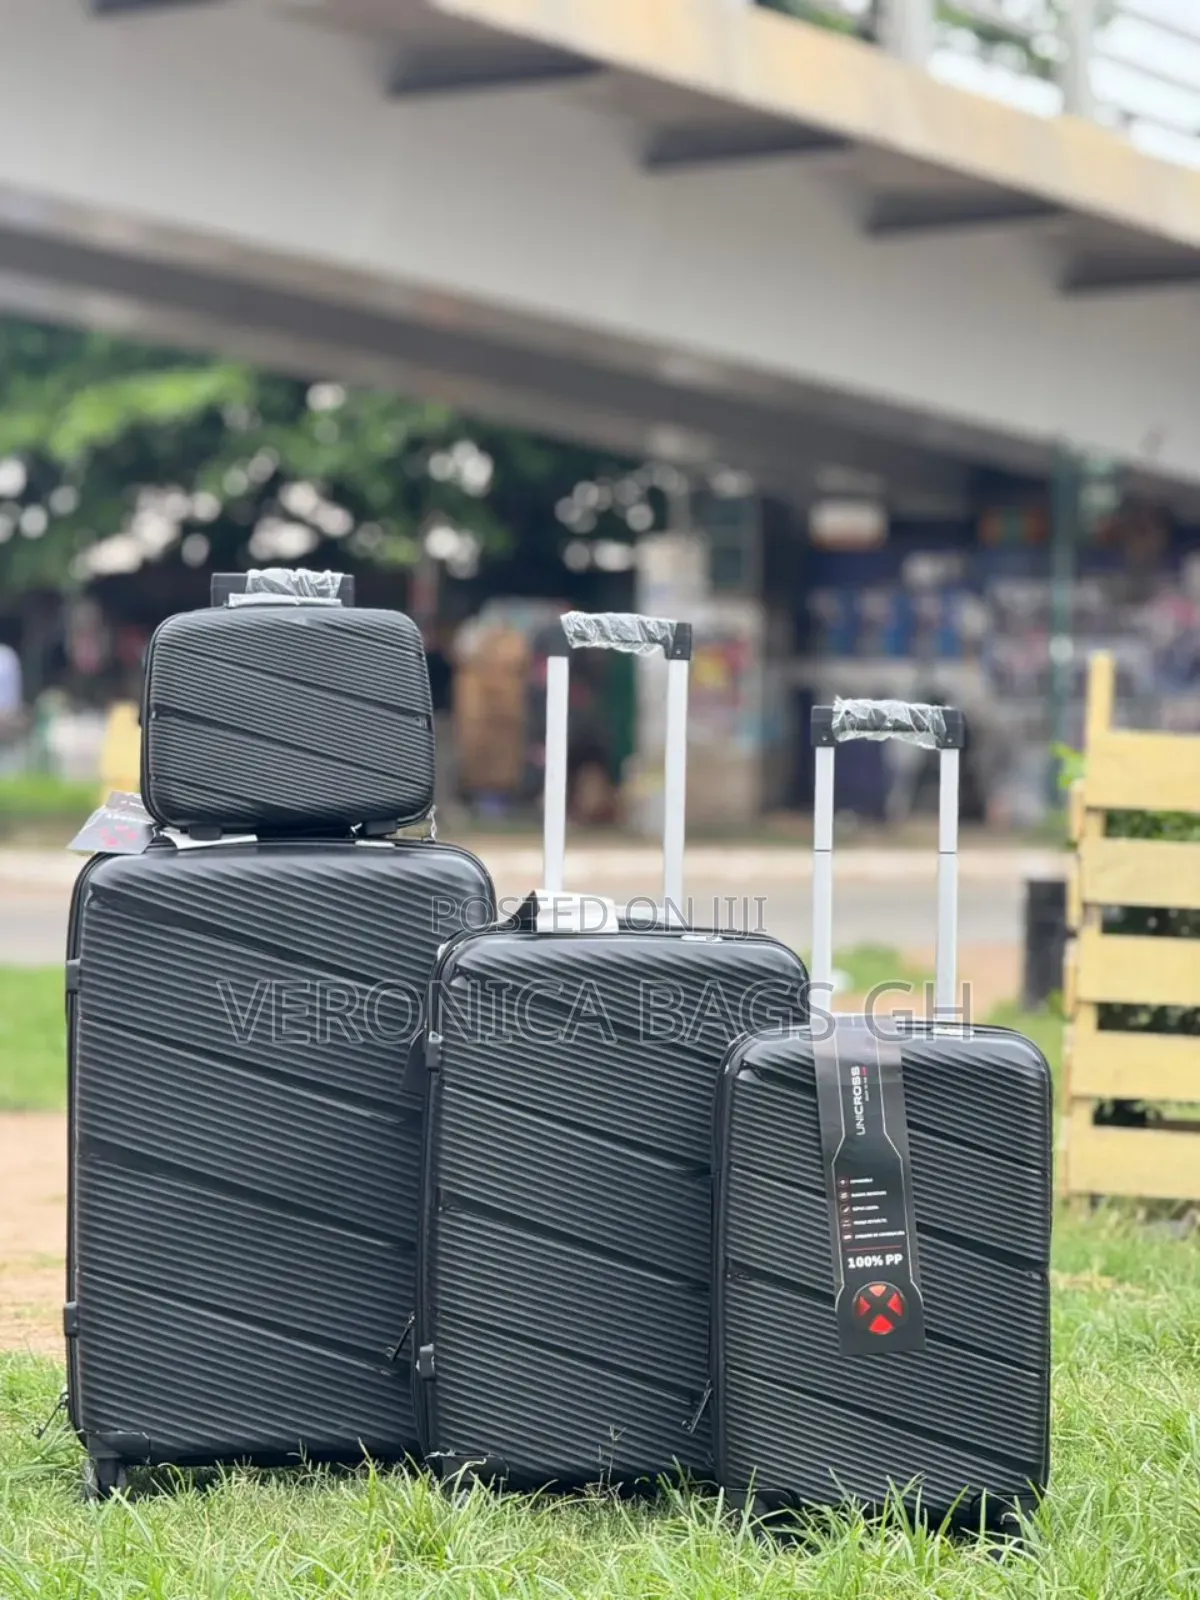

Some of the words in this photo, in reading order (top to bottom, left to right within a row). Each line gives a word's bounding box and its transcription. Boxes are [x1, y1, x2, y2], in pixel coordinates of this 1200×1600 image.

[850, 1065, 866, 1136] UNICROSS
[847, 1255, 884, 1269] 100%
[885, 1253, 903, 1266] PP
